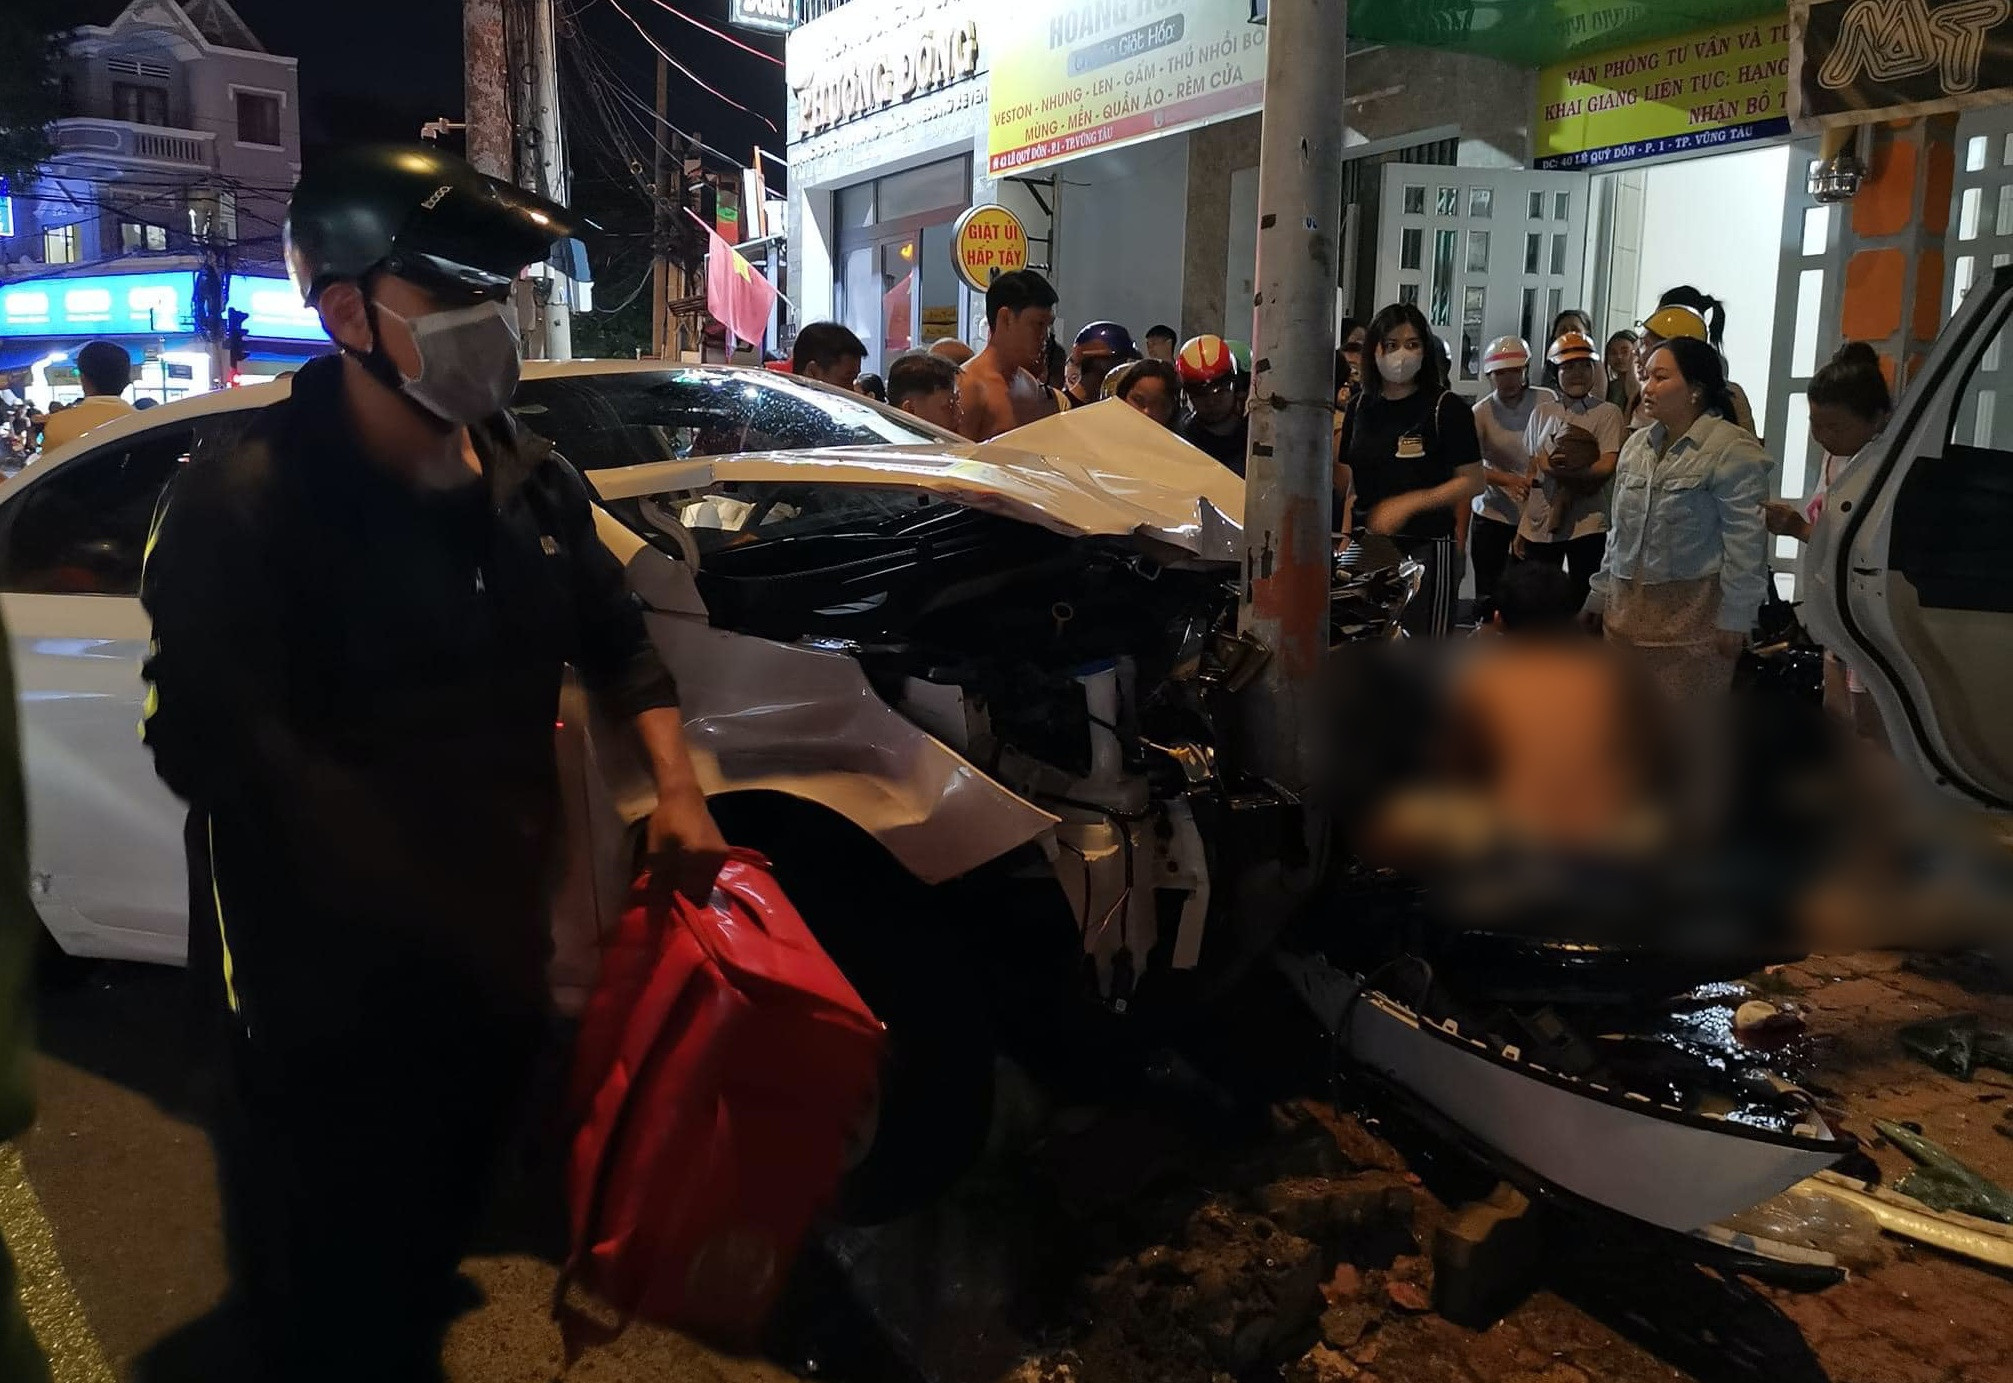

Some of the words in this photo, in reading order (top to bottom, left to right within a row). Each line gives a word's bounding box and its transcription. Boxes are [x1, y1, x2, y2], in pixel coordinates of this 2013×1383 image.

[1604, 53, 1659, 79] PHÒNG
[1738, 26, 1762, 50] VÀ
[993, 103, 1032, 126] VESTON
[1041, 88, 1082, 112] NHUNG
[1092, 77, 1113, 97] LEN
[1124, 59, 1156, 86] GẤM
[1168, 45, 1194, 74] THÚ
[1025, 120, 1058, 143] MÙNG
[1103, 91, 1139, 119] QUẦN
[1143, 87, 1164, 109] ÁO
[1177, 76, 1205, 99] RÈM
[1210, 62, 1243, 88] CỬA
[1545, 99, 1582, 121] KHAI
[1644, 78, 1683, 102] LIÊN
[1690, 71, 1730, 95] TỤC:
[1689, 98, 1739, 125] NHẬN
[1575, 151, 1588, 165] LÊ
[1591, 147, 1611, 164] QUÝ
[1614, 143, 1636, 159] ĐÔN
[1675, 136, 1693, 149] TP.
[1695, 130, 1726, 146] VŨNG
[1730, 124, 1754, 140] TÀU
[1005, 220, 1018, 240] ỦI
[966, 244, 994, 265] HẤP
